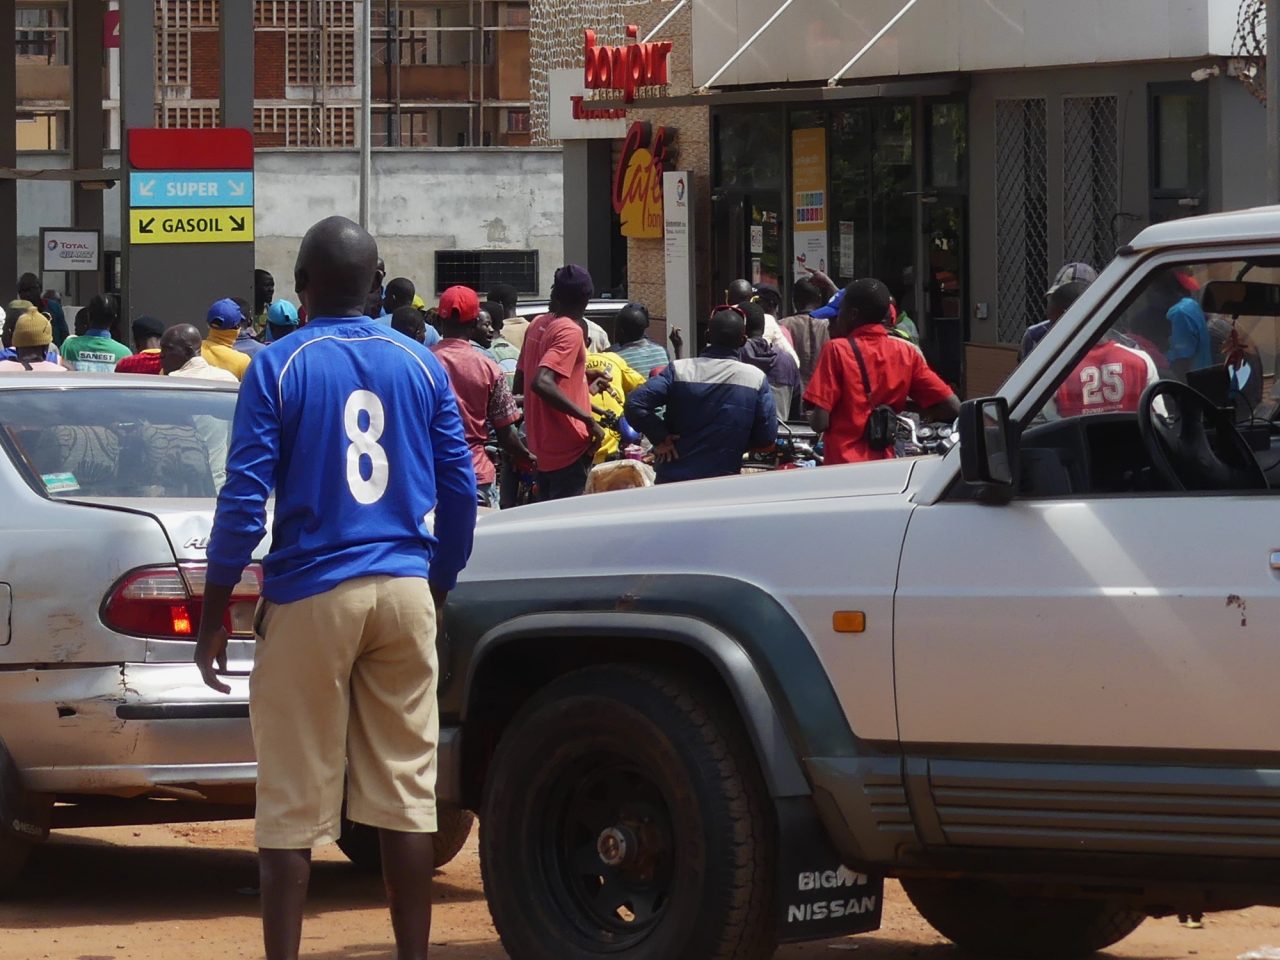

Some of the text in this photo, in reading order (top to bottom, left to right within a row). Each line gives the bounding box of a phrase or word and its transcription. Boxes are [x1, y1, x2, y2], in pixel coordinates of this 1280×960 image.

[166, 182, 219, 196] SUPER
[162, 218, 223, 233] GASOIL
[1080, 362, 1125, 405] 25
[344, 389, 389, 504] 8
[787, 895, 876, 923] NISSAN
